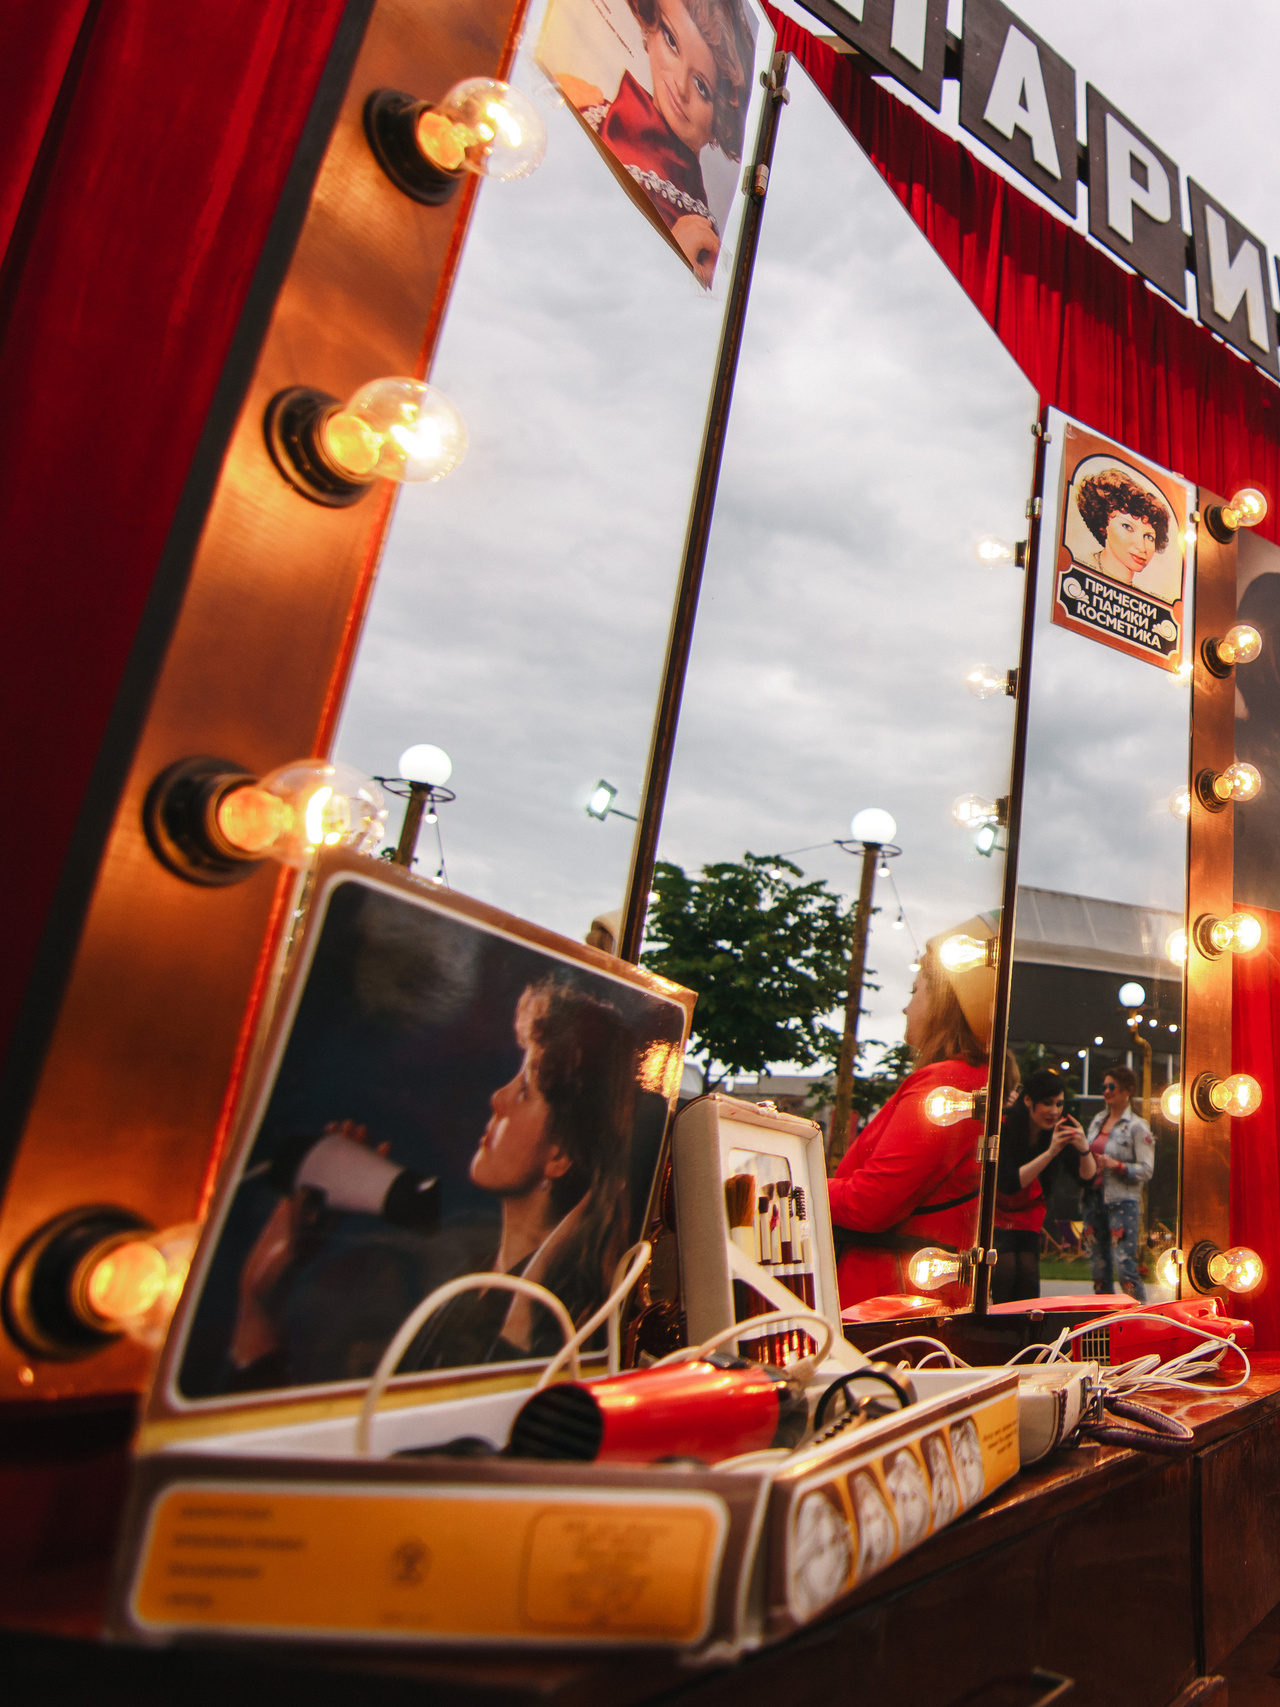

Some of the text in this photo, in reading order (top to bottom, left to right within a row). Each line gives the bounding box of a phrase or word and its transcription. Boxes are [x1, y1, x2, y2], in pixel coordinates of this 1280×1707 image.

[1085, 577, 1157, 620] ПРИЧЕСКИ
[1093, 595, 1149, 630] ПАРИКИ
[1077, 602, 1161, 649] КОСМЕТИКА
